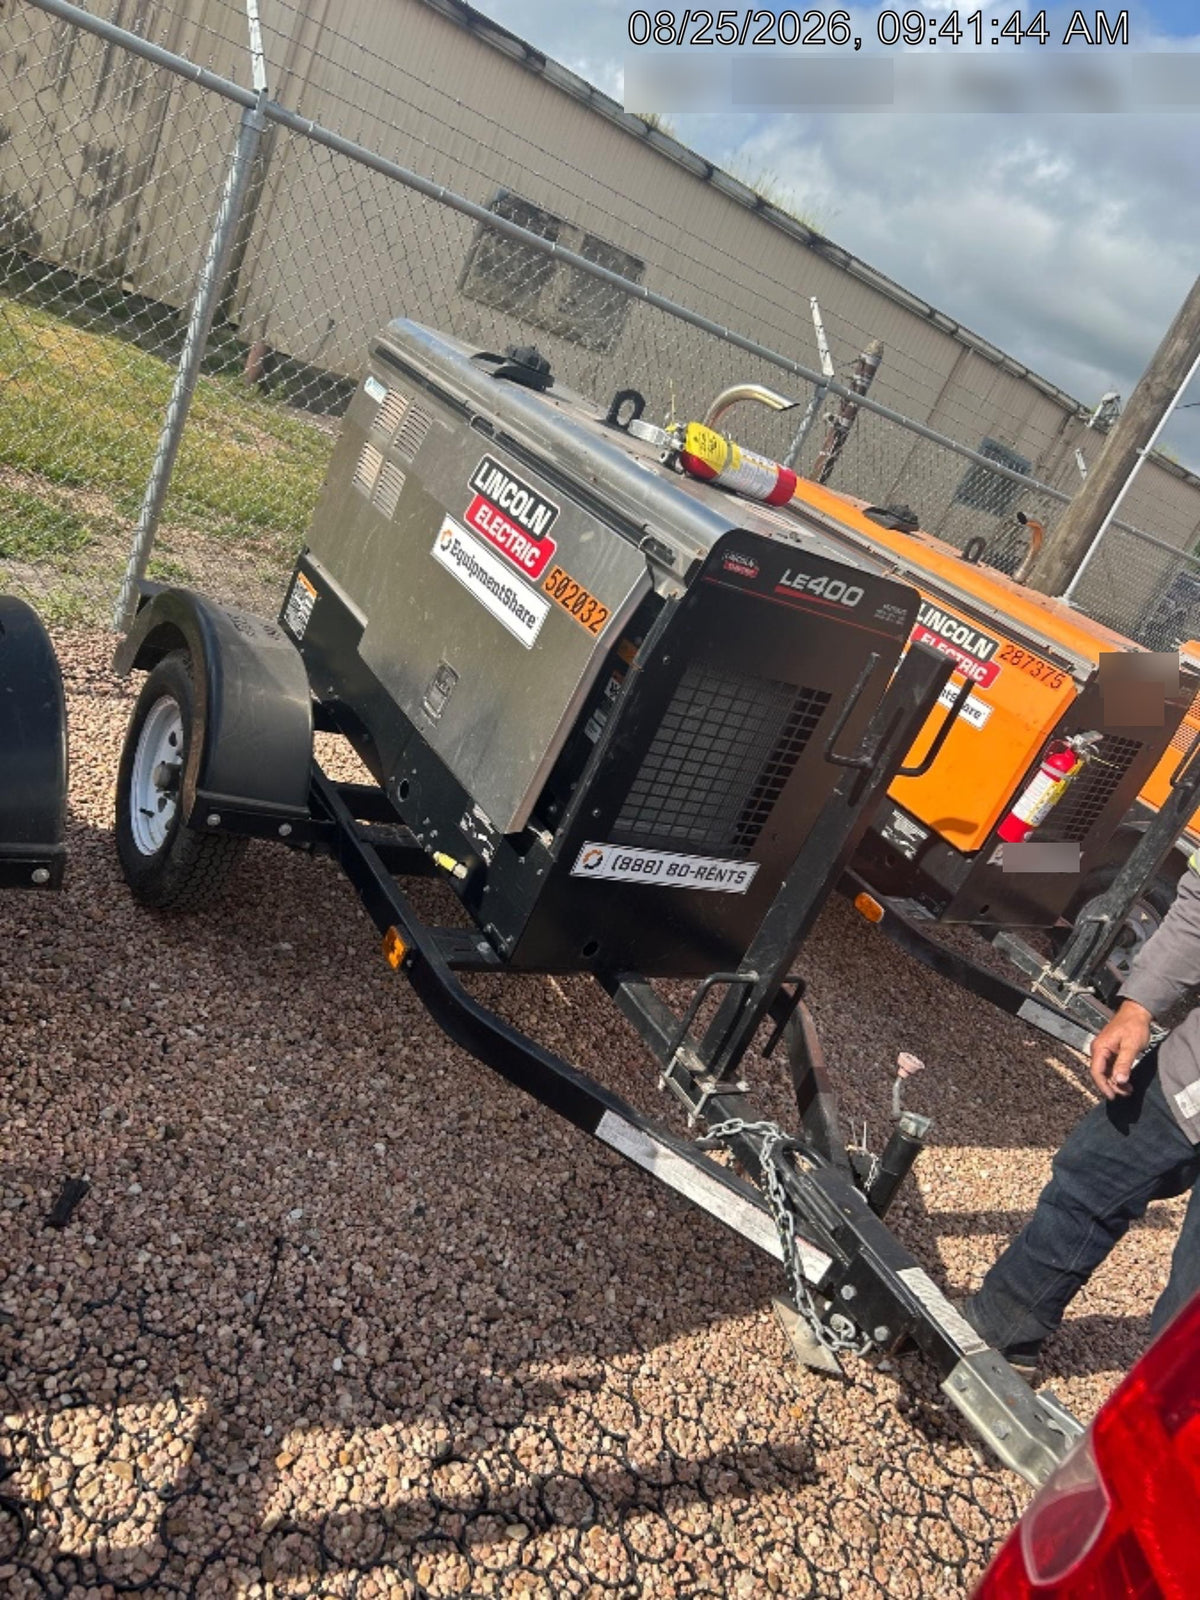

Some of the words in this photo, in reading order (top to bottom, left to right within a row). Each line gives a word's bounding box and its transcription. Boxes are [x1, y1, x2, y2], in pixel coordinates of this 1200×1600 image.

[474, 462, 551, 536] LINCOLN
[474, 504, 541, 568] ELECTRIC
[450, 538, 536, 629] EquipmentShare
[545, 568, 607, 634] 502032
[779, 569, 864, 607] LE400
[917, 602, 993, 659] LINCOLN
[999, 645, 1066, 689] 287375
